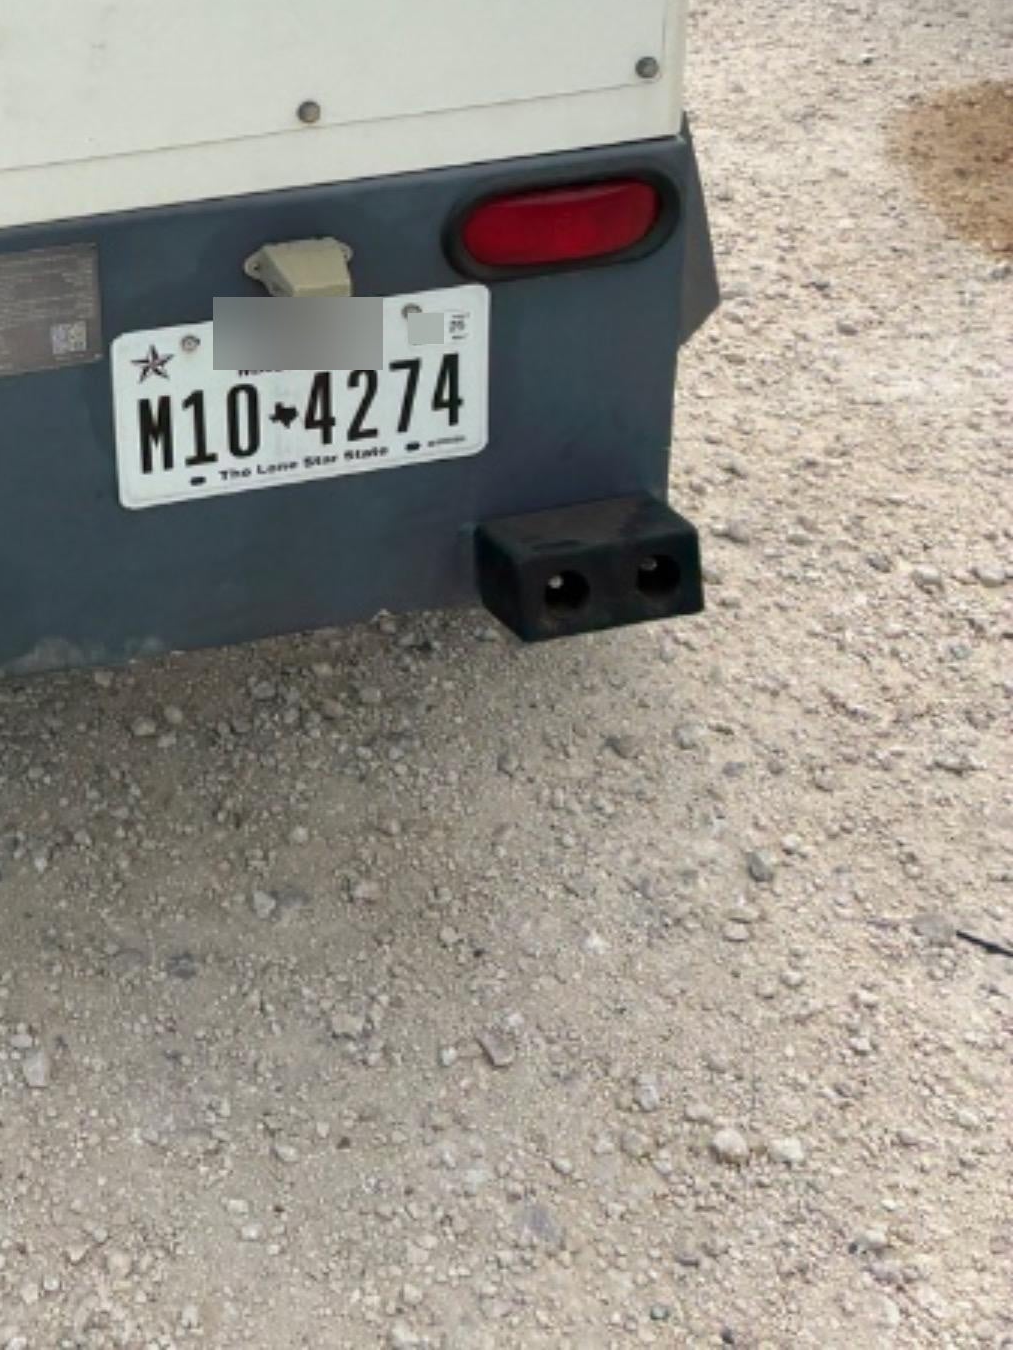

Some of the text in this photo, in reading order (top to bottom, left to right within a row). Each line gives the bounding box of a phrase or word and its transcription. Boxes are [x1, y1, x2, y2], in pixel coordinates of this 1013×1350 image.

[219, 446, 389, 481] The Lone Star State
